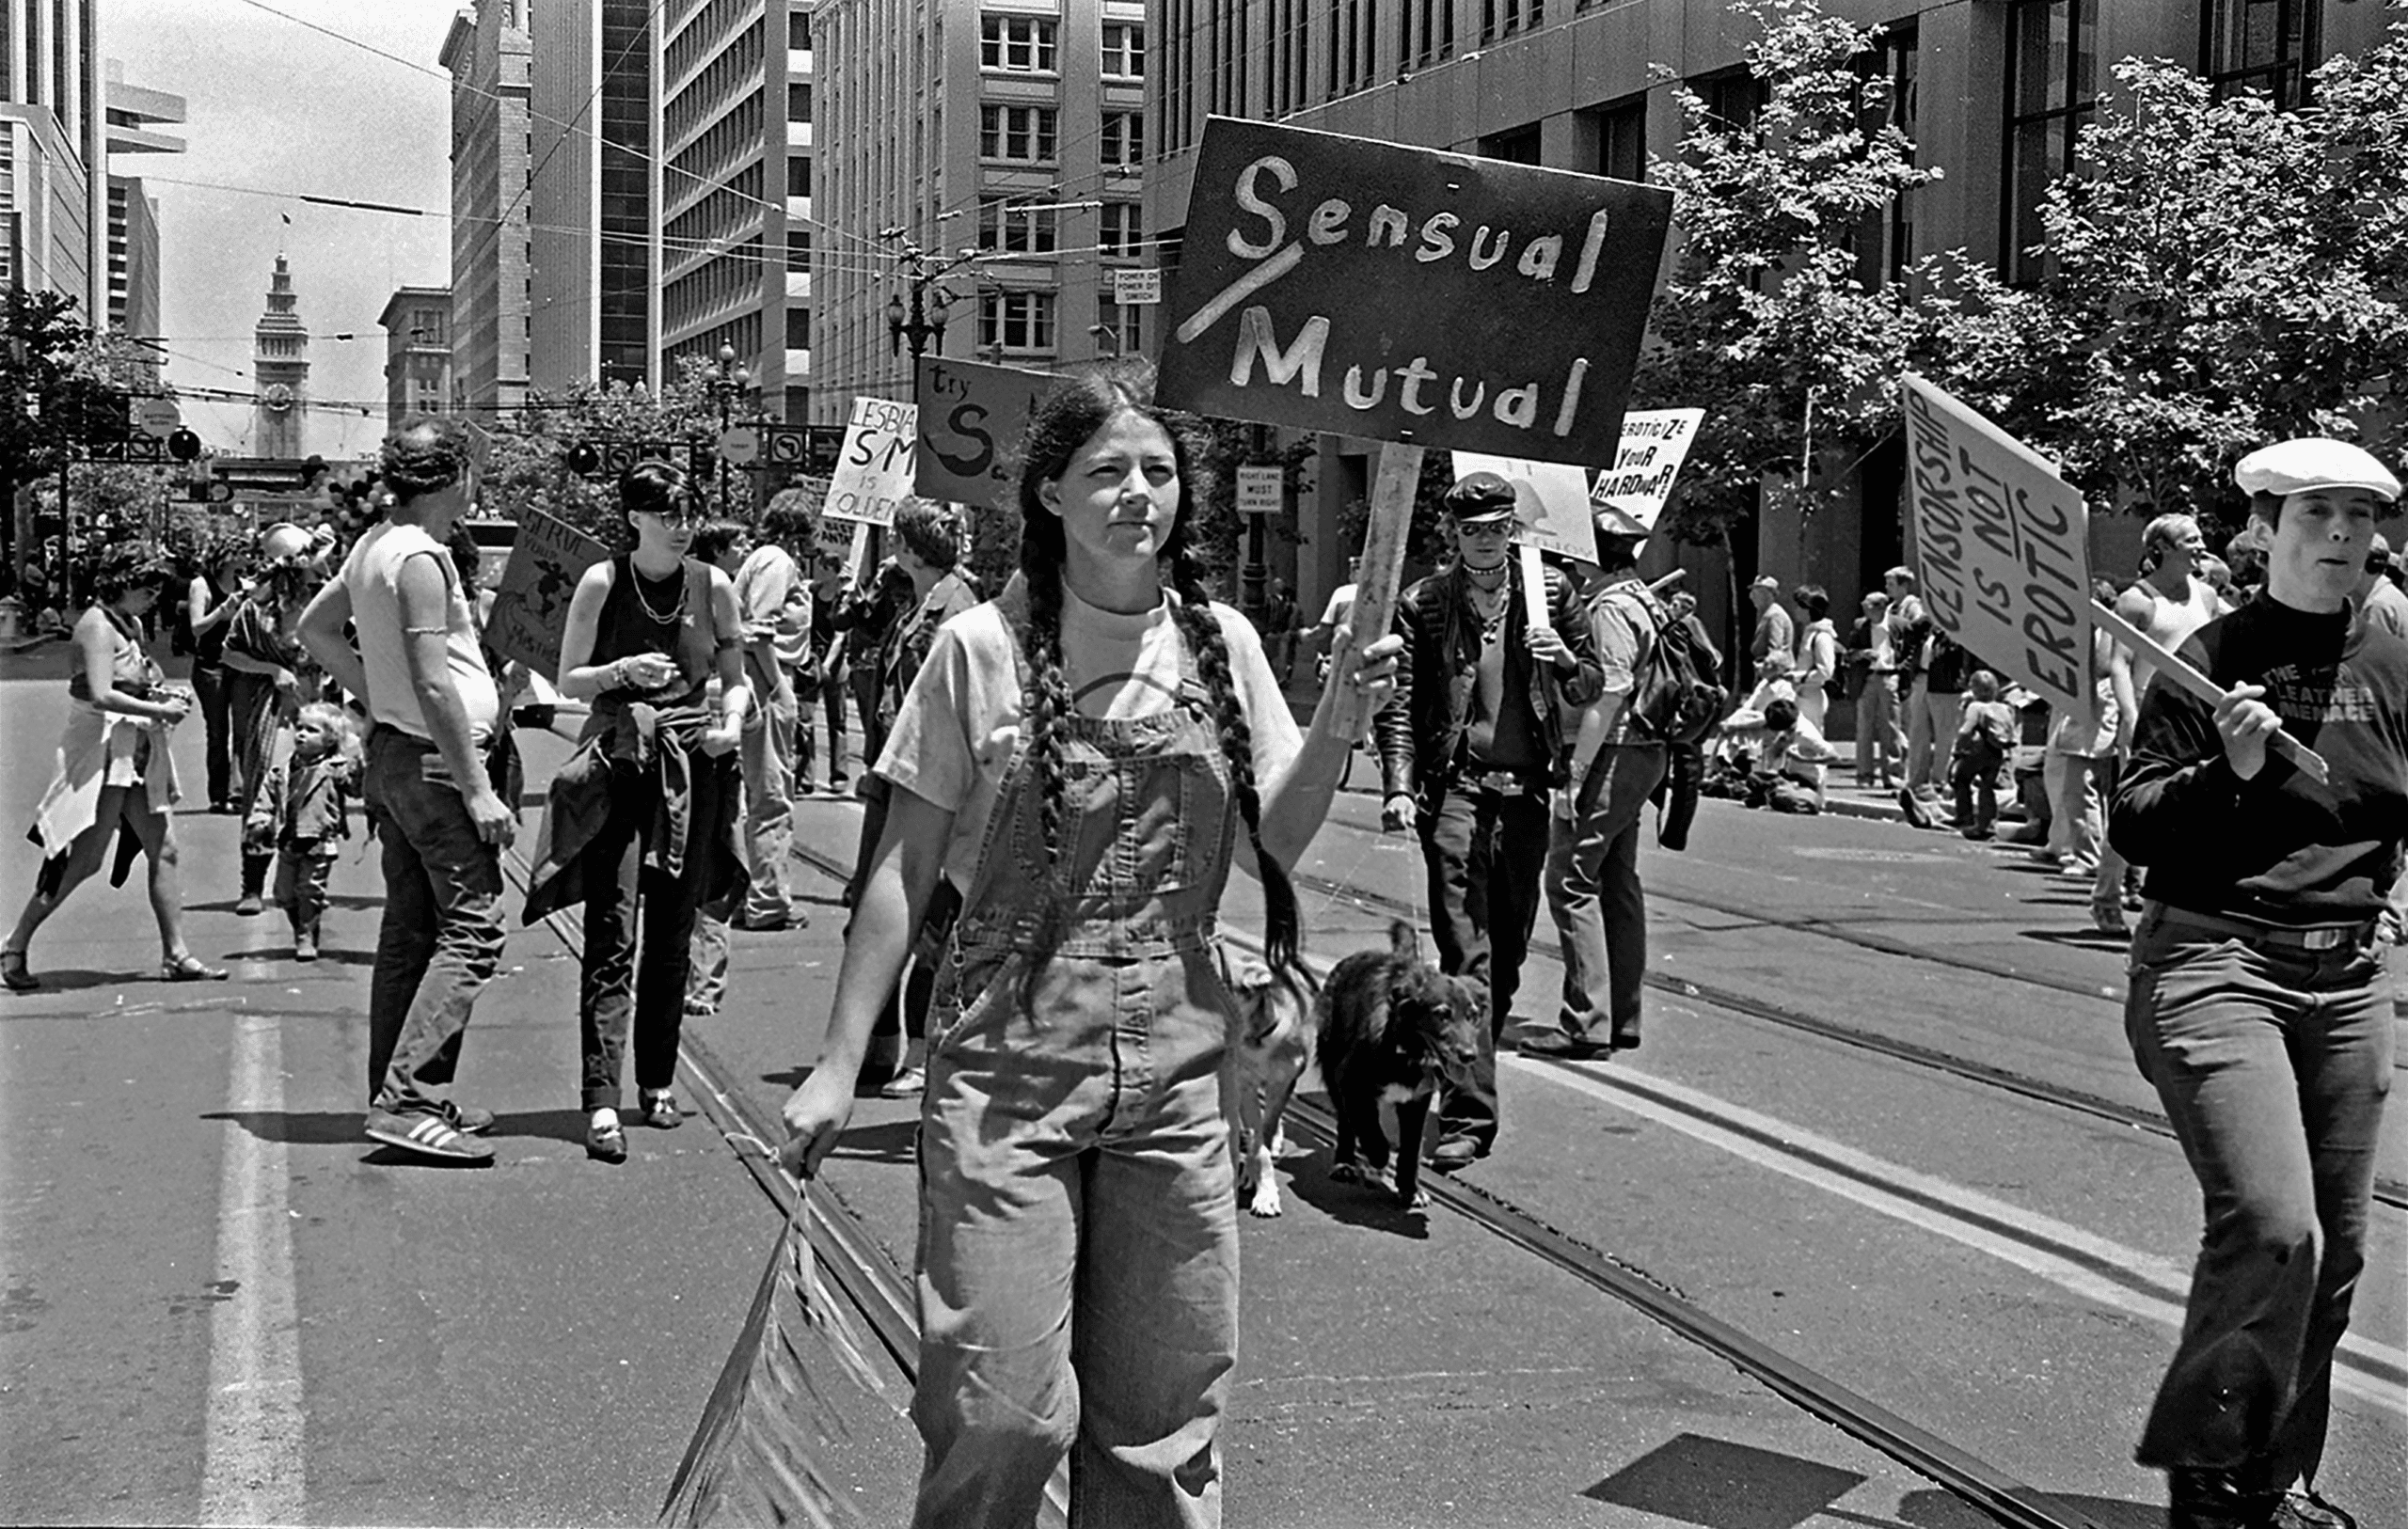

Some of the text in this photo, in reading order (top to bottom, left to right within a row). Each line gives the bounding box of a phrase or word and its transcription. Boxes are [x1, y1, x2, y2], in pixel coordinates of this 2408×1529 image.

[1227, 155, 1608, 294] Sensual
[1117, 282, 1143, 291] POWER
[1118, 273, 1144, 281] POWER
[1229, 305, 1591, 438] Mutual
[927, 363, 973, 404] try
[849, 401, 917, 437] LESBIA
[859, 475, 877, 490] IS
[1261, 472, 1280, 481] LANE
[1246, 484, 1273, 495] MUST
[1259, 498, 1281, 507] RIGHT
[1909, 386, 1965, 633] CENSORSHIP
[1957, 444, 2014, 627] IS NOT
[2015, 487, 2081, 700] EROTIC
[2261, 663, 2302, 686] THE
[2273, 685, 2376, 705] LEATHER
[2278, 700, 2375, 723] MENACE
